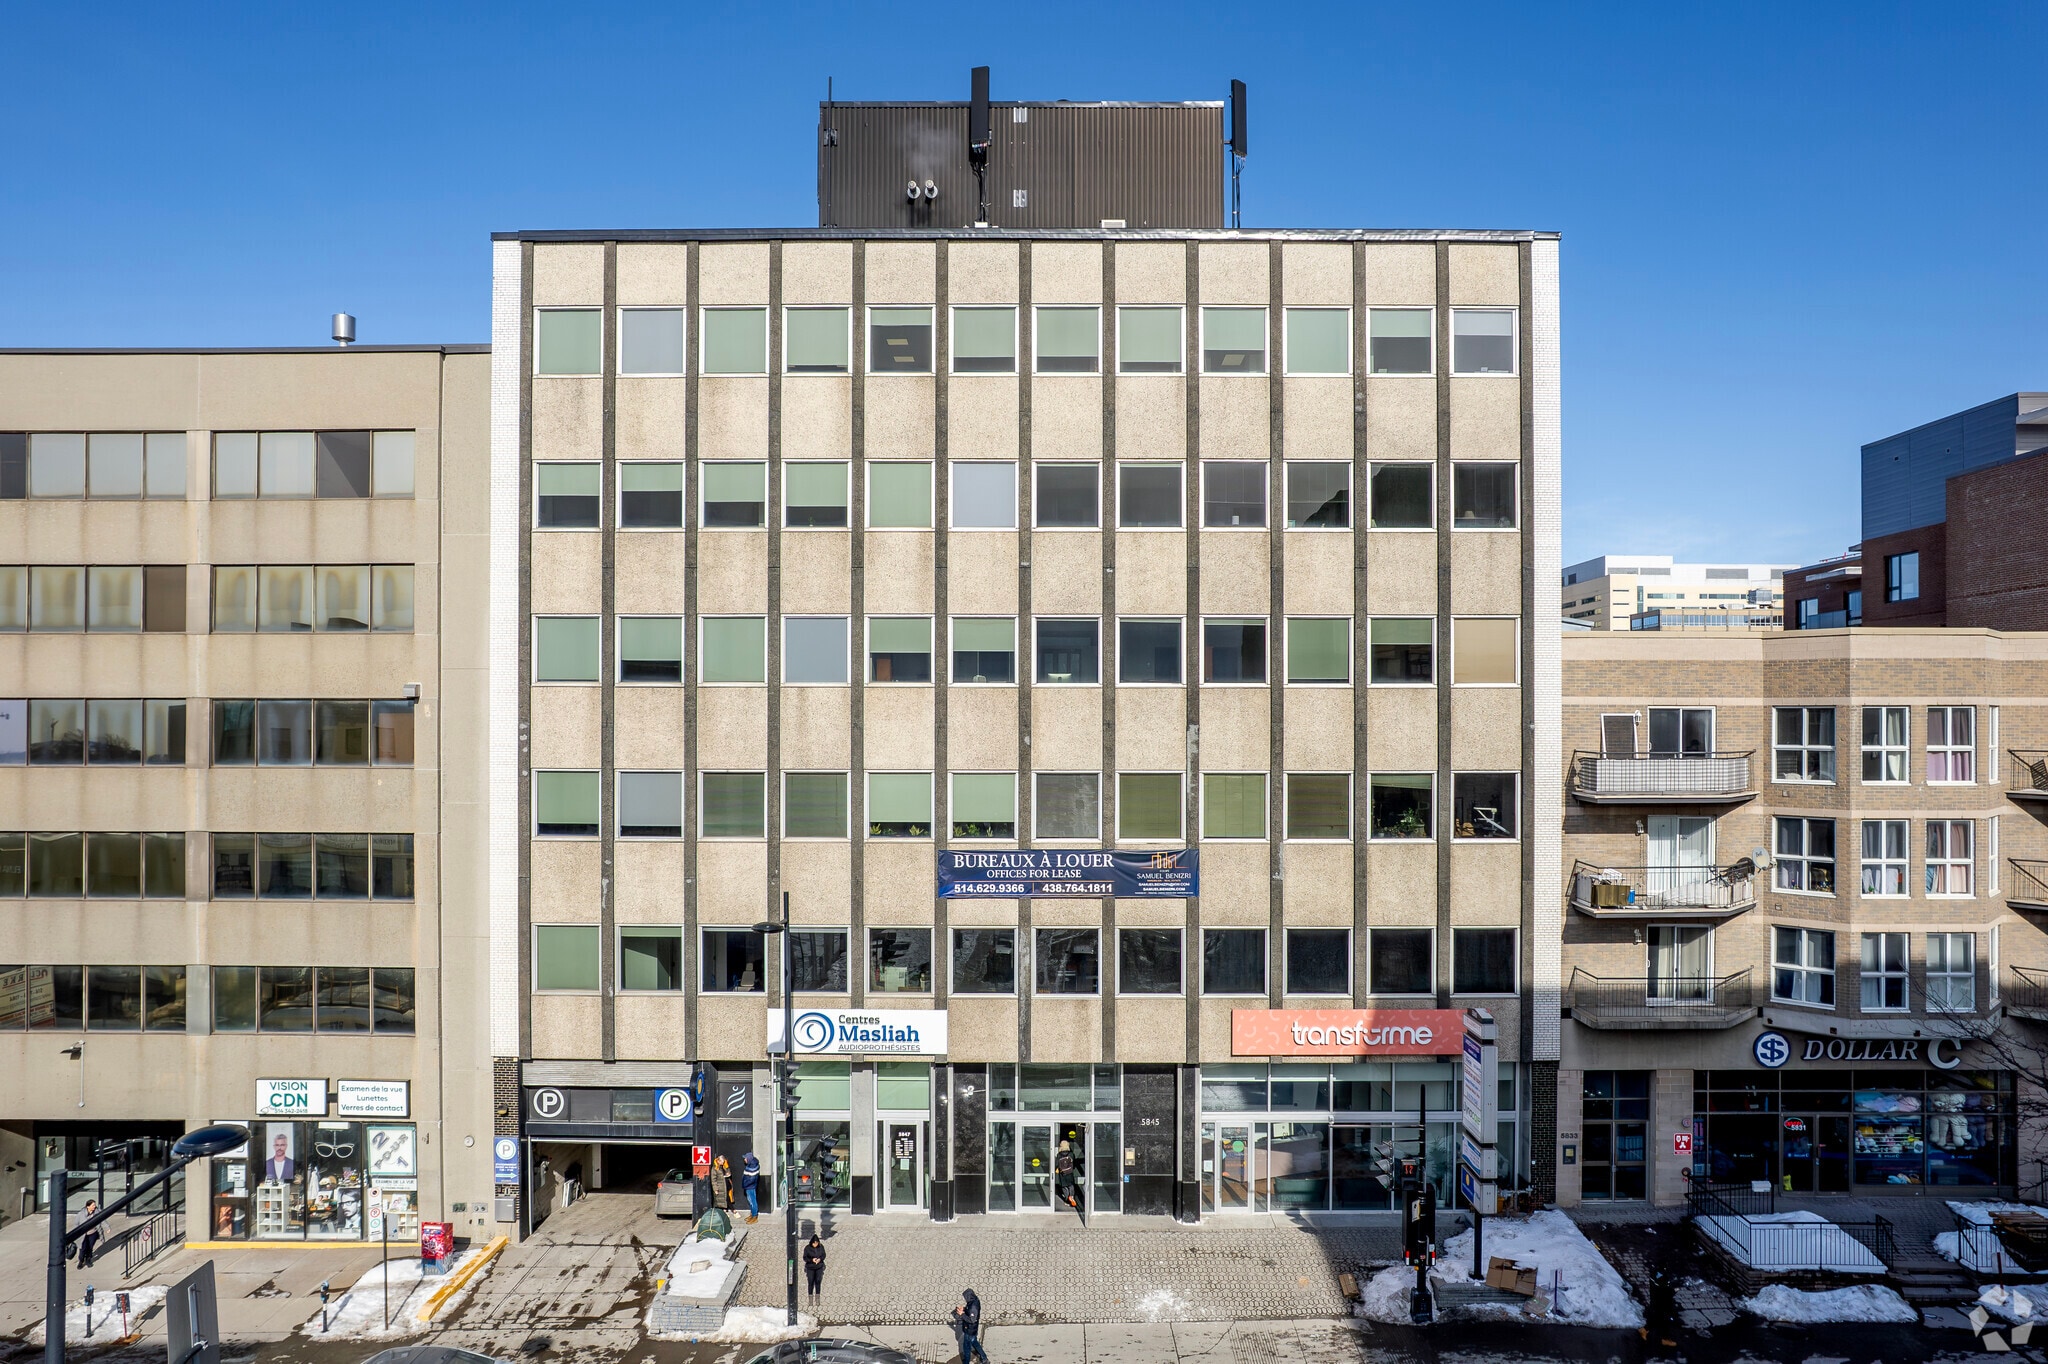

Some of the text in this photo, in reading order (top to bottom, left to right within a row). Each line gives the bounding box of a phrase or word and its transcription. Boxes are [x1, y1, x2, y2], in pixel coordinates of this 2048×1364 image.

[953, 850, 1115, 869] BUREAUX À LOUER
[986, 869, 1082, 879] OFFICES FOR LEASE
[1136, 872, 1164, 880] SAMUEL
[954, 883, 1113, 893] 514.629.9366 438.764.1811
[838, 1014, 880, 1025] Centres
[838, 1025, 920, 1042] Masliah
[838, 1043, 921, 1051] AUDIOPROTHÉSISTES
[1802, 1039, 1918, 1061] DOLLAR
[1927, 1038, 1963, 1070] C
[269, 1081, 308, 1091] VISION
[341, 1085, 370, 1093] Examen
[371, 1085, 381, 1093] de
[381, 1085, 389, 1093] la
[269, 1093, 308, 1108] CDN
[542, 1092, 558, 1113] P
[669, 1095, 682, 1114] P
[1140, 1118, 1160, 1126] 5845
[372, 1131, 390, 1150] 2
[502, 1144, 511, 1155] P
